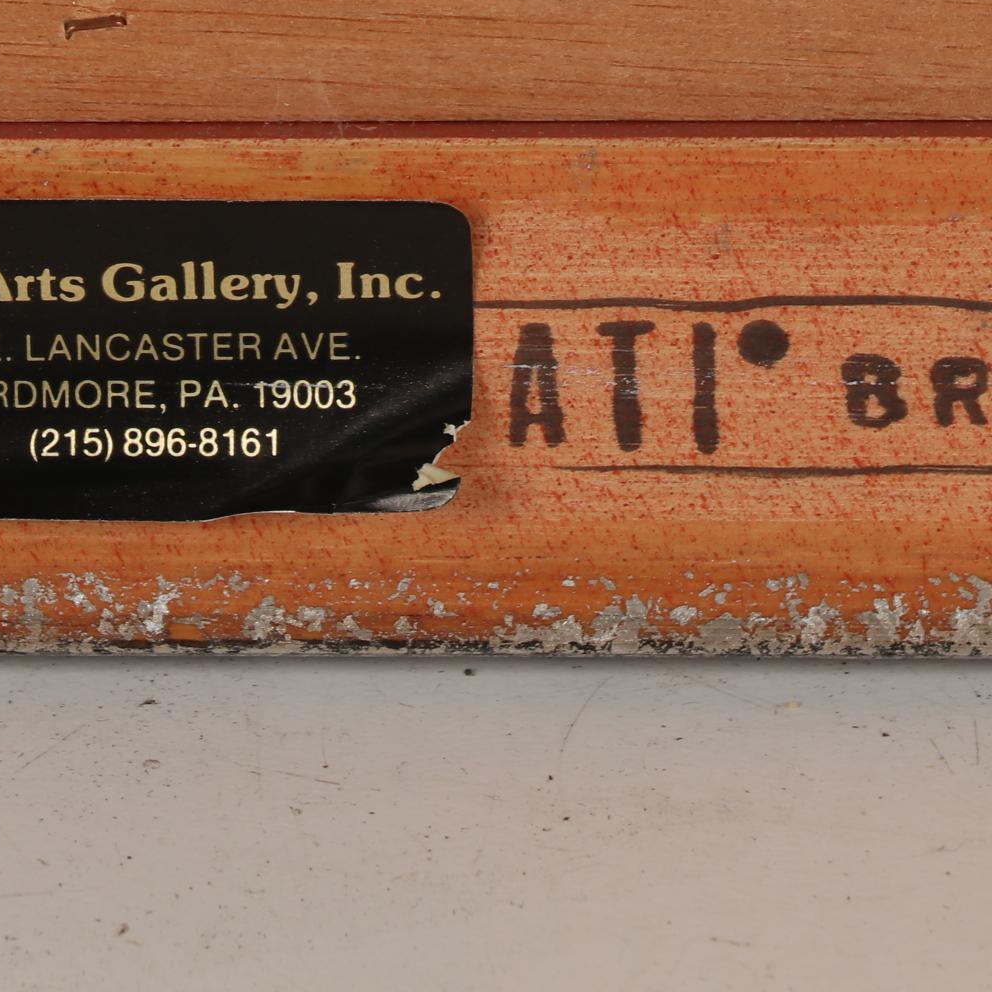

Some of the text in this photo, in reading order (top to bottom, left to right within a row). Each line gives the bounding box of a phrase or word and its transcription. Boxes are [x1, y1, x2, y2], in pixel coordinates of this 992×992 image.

[102, 261, 320, 311] Gallery,
[337, 262, 442, 300] Inc.
[26, 333, 262, 363] LANCASTER
[273, 333, 362, 362] AVE.
[180, 380, 240, 410] PA.
[254, 380, 358, 410] 19003
[30, 428, 279, 463] (215) 896-8161
